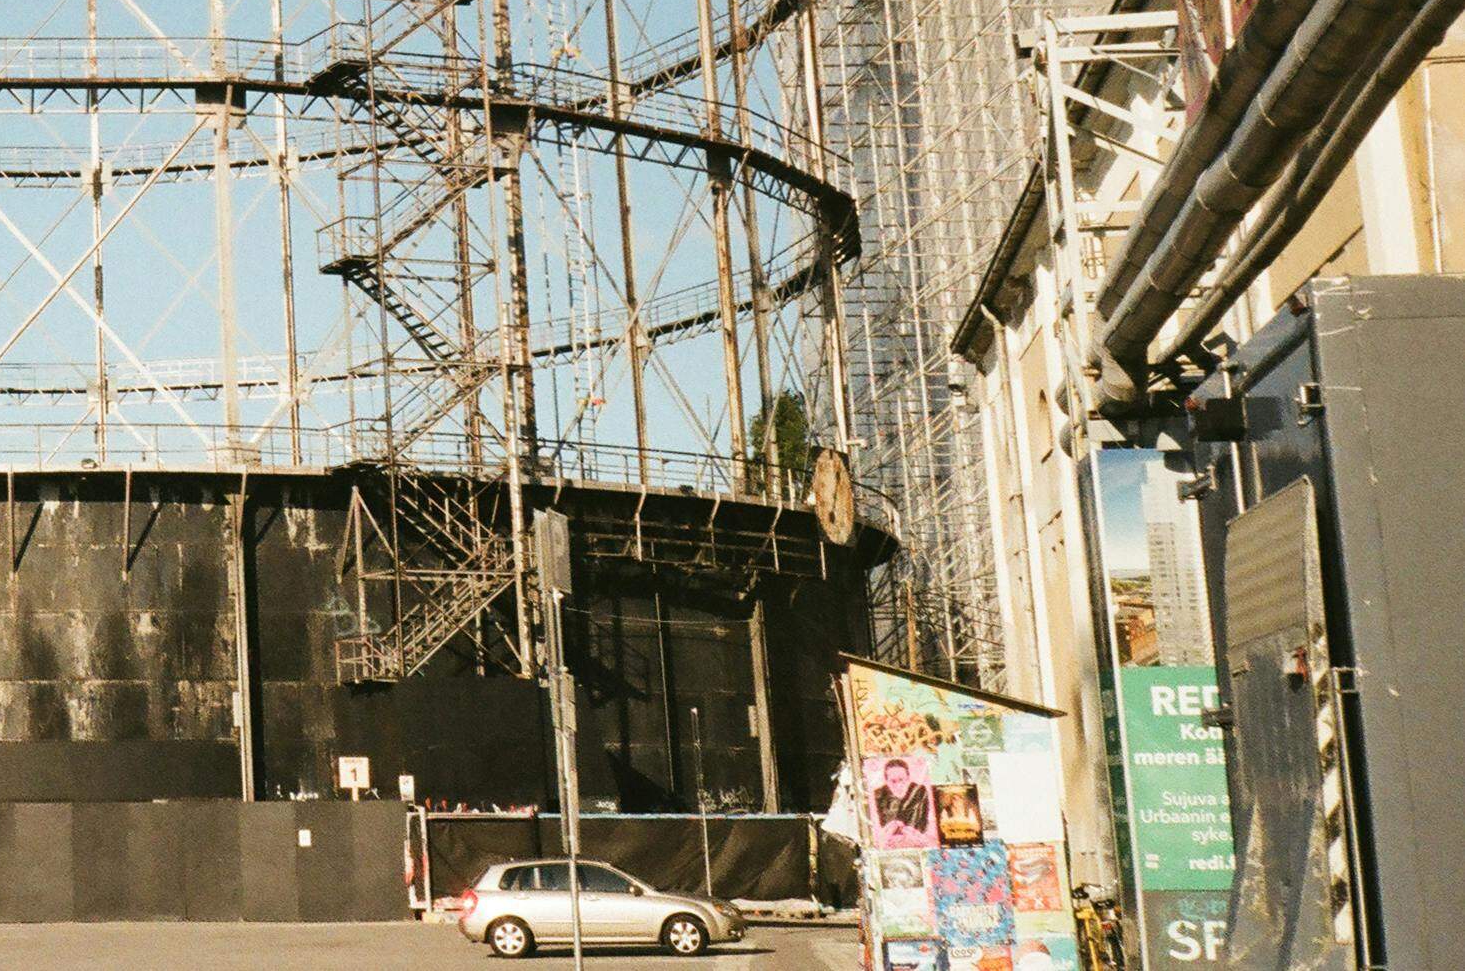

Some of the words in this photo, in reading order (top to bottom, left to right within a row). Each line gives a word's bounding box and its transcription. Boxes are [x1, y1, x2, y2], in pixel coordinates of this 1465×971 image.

[1134, 752, 1200, 765] meren
[1163, 791, 1217, 809] Sujuva
[1140, 809, 1216, 824] Urbaanin
